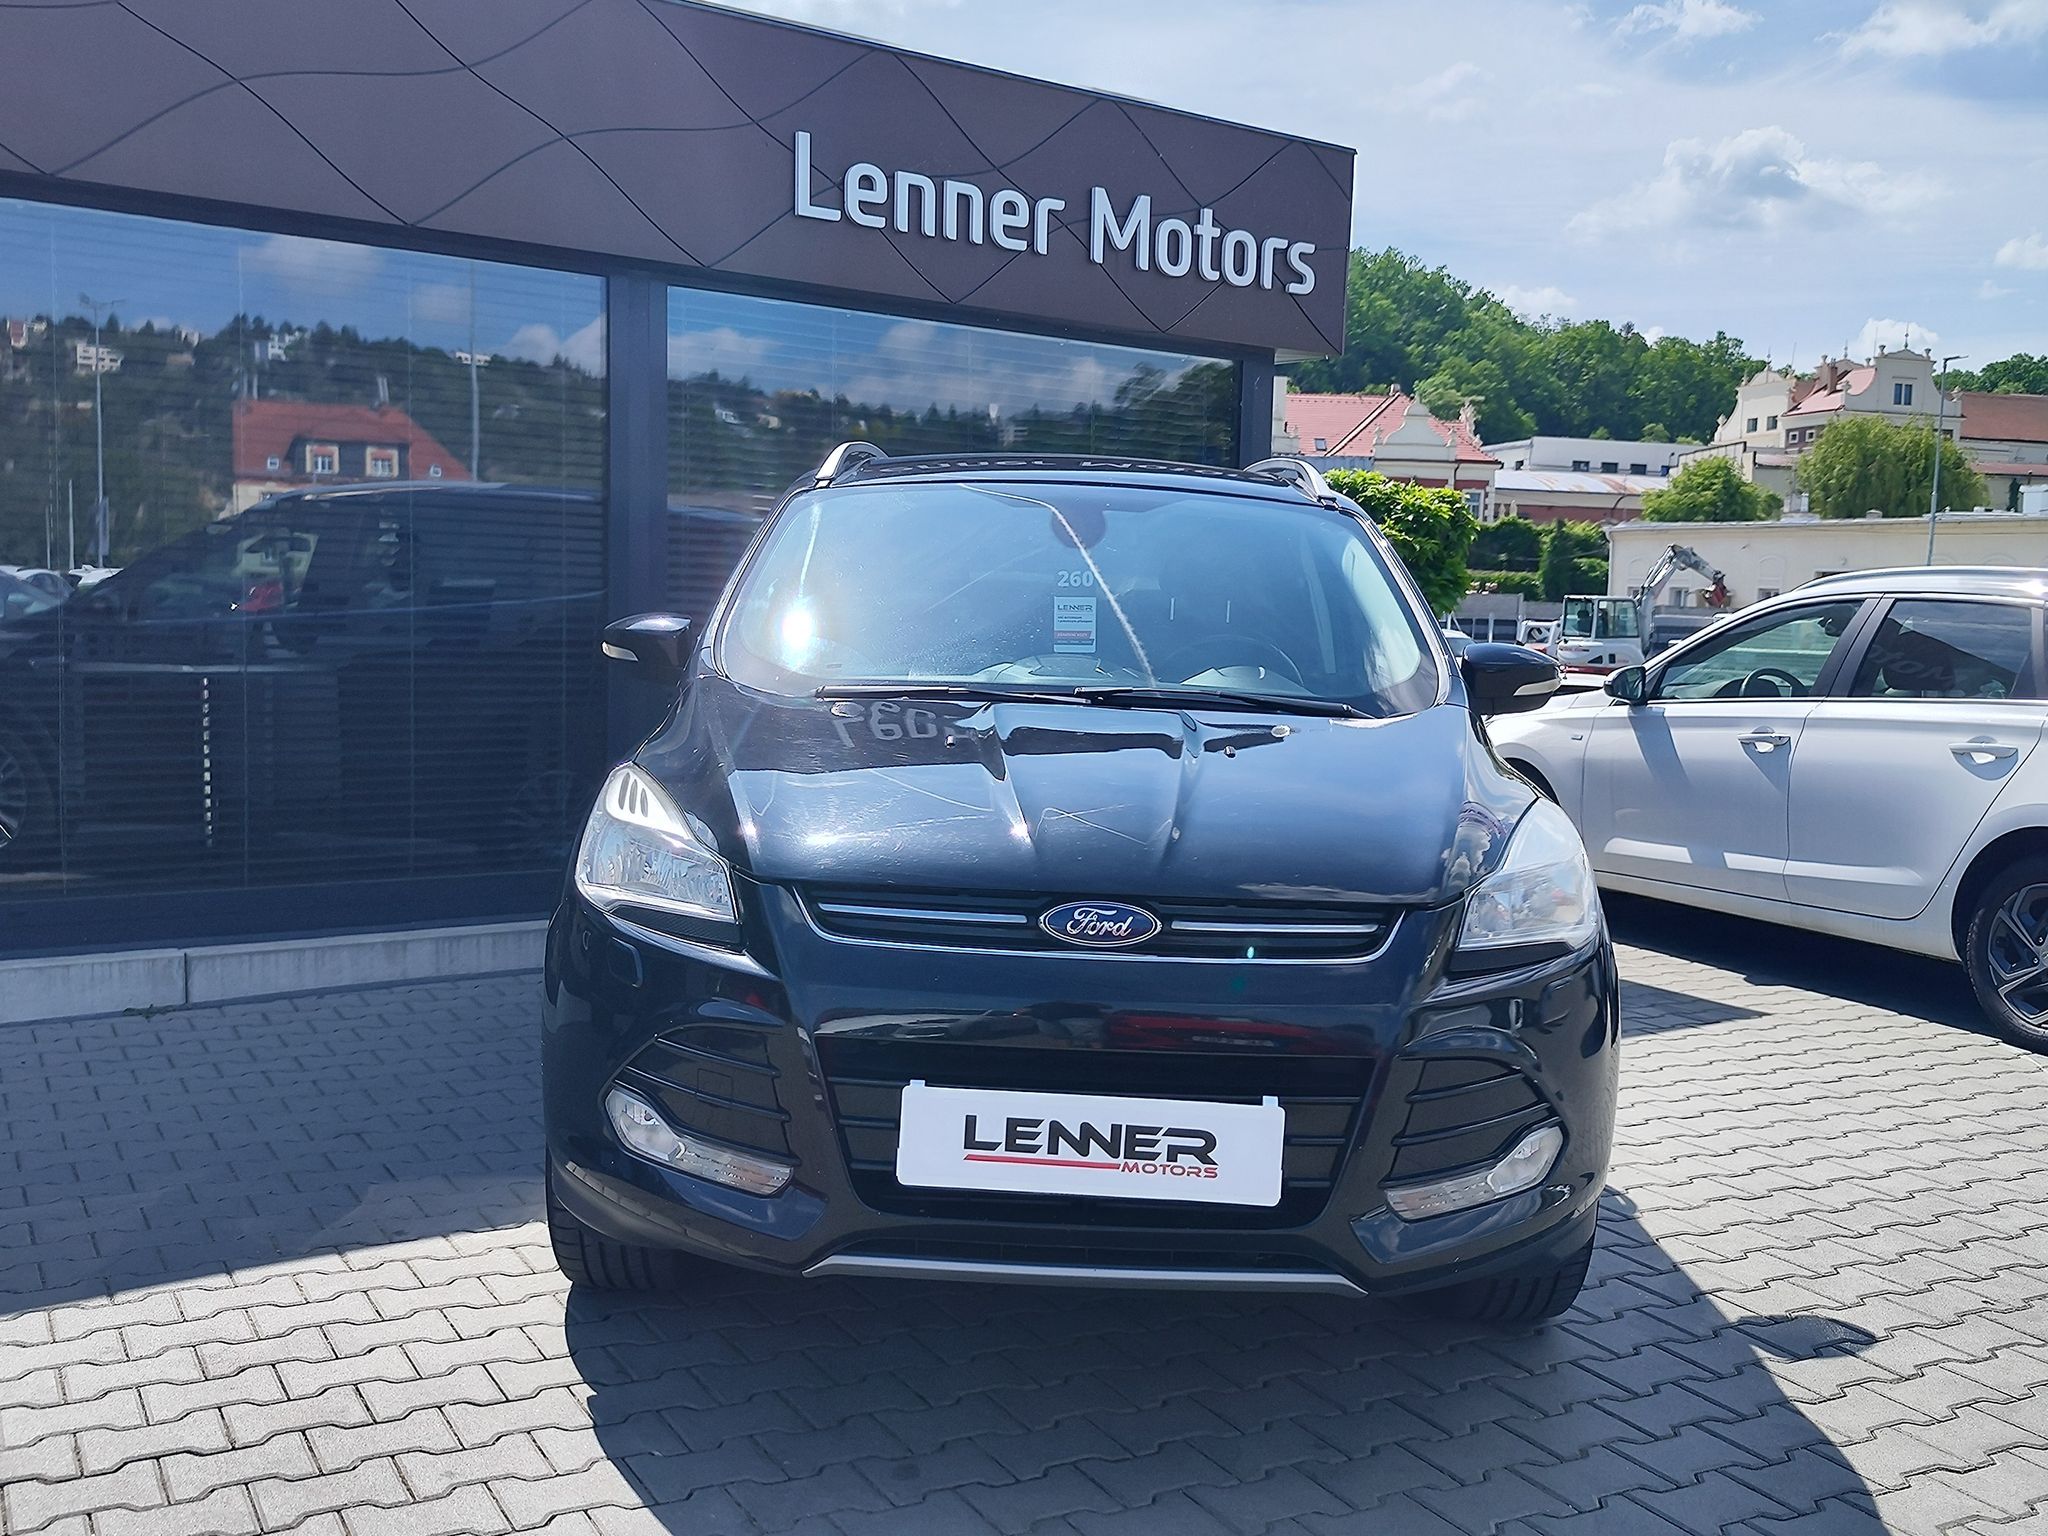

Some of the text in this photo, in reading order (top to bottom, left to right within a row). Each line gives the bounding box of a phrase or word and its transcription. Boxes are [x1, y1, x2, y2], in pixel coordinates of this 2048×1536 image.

[795, 131, 1317, 294] Lenner Motors
[1057, 570, 1094, 587] 260
[1066, 907, 1133, 936] Ford
[963, 1114, 1218, 1165] LENNER
[1121, 1162, 1218, 1179] MOTORS
